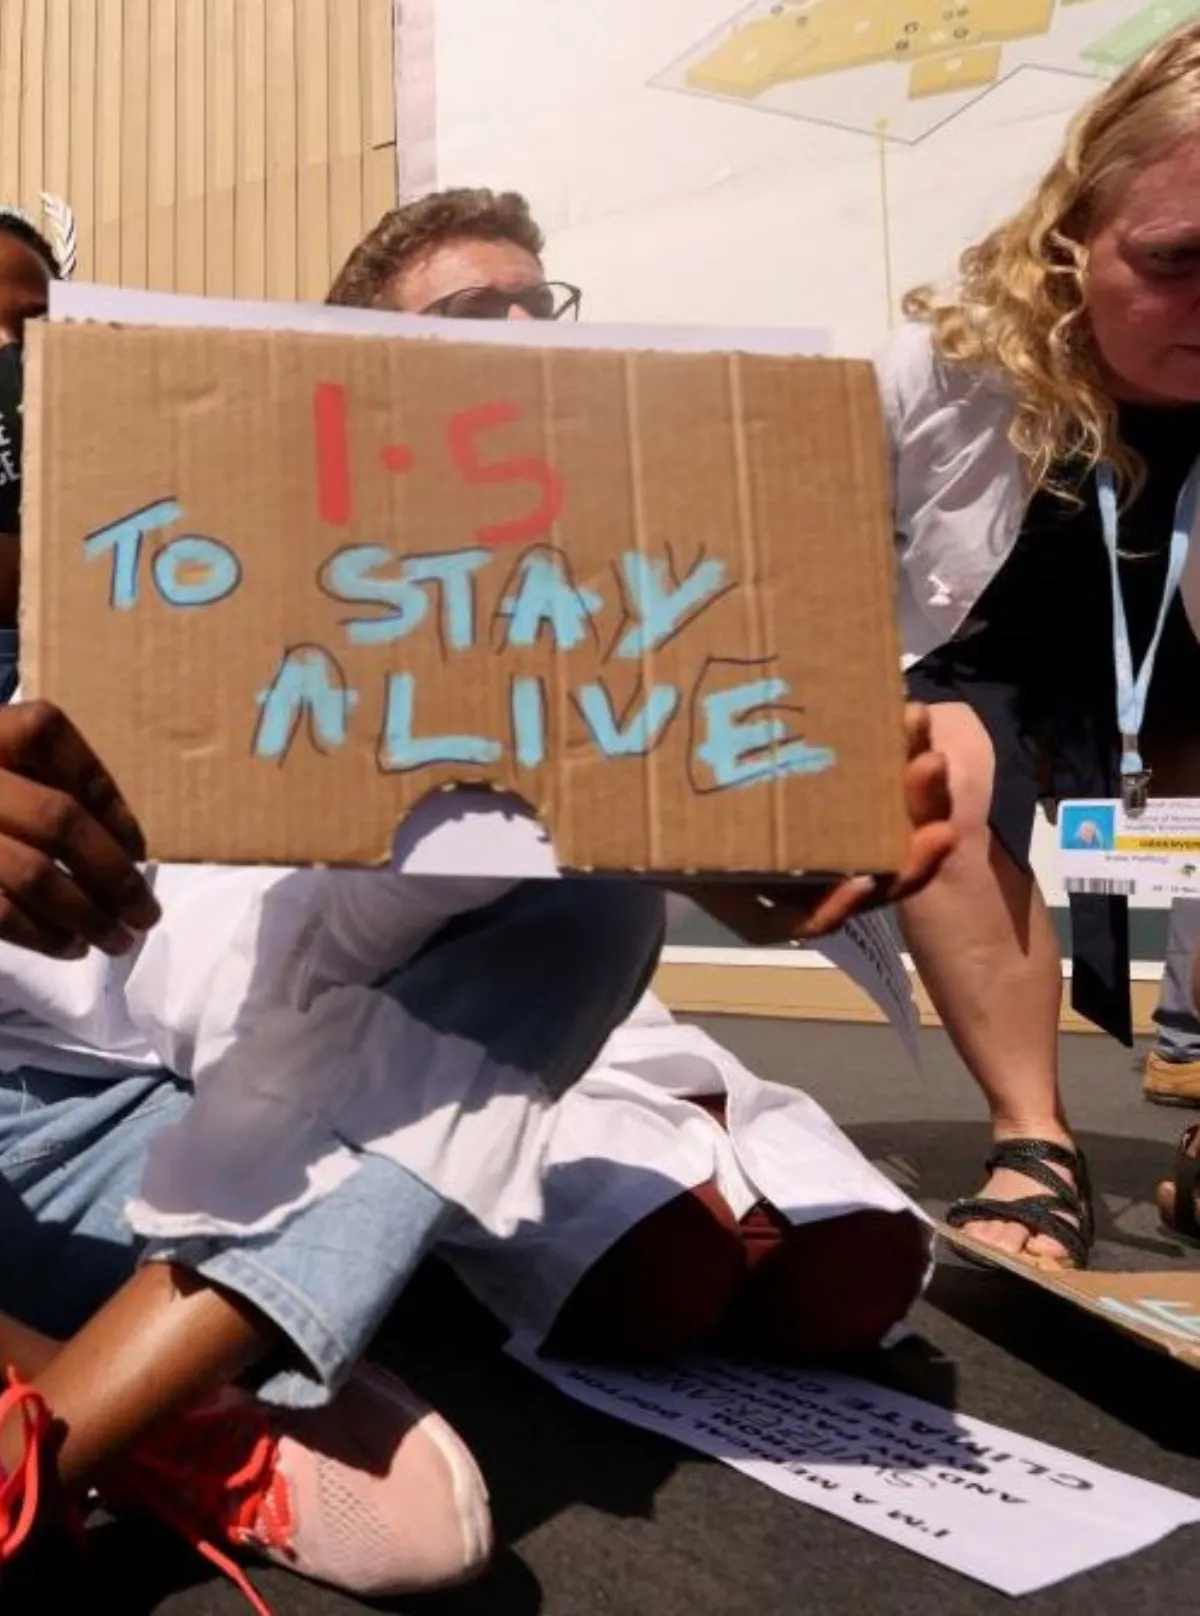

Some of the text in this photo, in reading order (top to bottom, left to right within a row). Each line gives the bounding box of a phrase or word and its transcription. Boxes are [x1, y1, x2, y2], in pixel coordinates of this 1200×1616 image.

[83, 496, 738, 663] TO STAY
[250, 641, 836, 794] ALIVE
[841, 1398, 1094, 1490] CLIMATE
[852, 1493, 878, 1505] A
[938, 1473, 1029, 1504] AND
[887, 1511, 949, 1538] I'M
